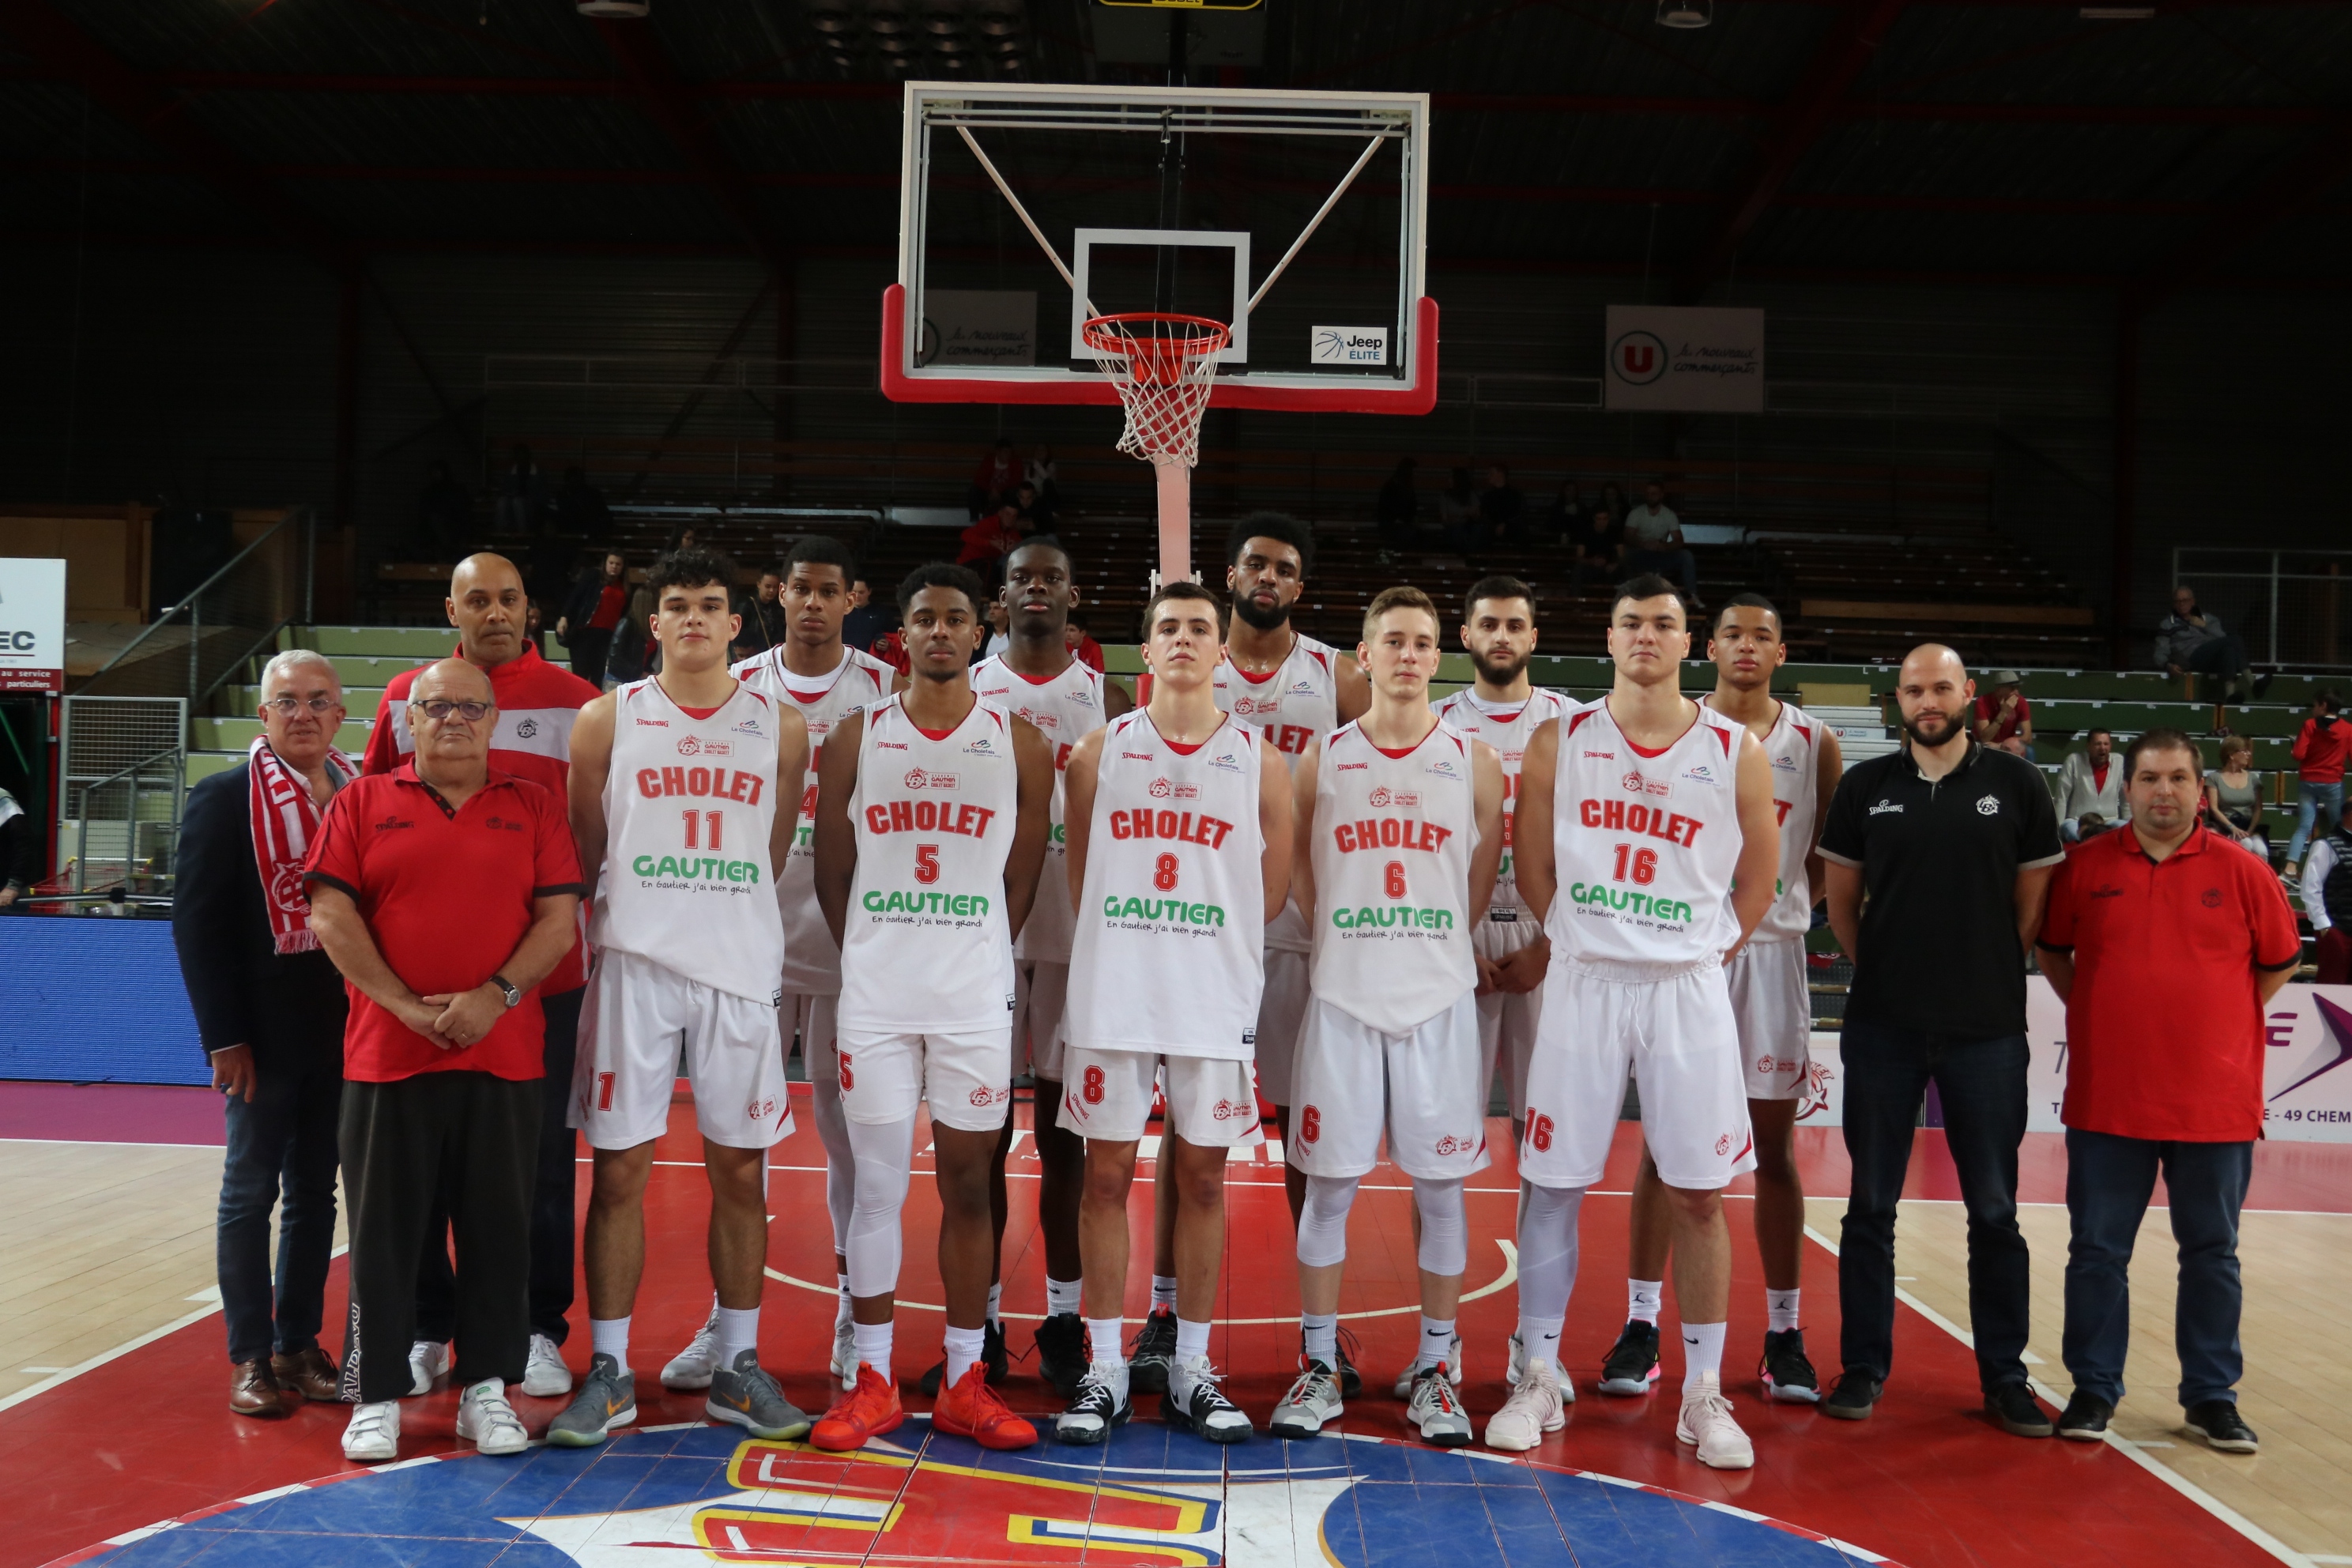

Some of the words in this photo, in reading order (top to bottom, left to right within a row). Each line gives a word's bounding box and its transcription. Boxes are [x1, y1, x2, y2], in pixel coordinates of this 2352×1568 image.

[1347, 335, 1382, 349] Jeep
[1349, 349, 1381, 360] ÉLITE
[1624, 345, 1653, 373] U
[982, 688, 1009, 696] SPALDING
[636, 718, 669, 728] SPALDING
[877, 742, 908, 751] SPALDING
[1265, 724, 1314, 755] LET
[1122, 752, 1153, 761] SPALDING
[1215, 762, 1238, 771] Choletais
[1337, 762, 1368, 771] SPALDING
[1583, 751, 1614, 760] SPALDING
[635, 766, 764, 807] CHOLET
[1433, 769, 1457, 778] Choletais
[865, 801, 996, 839] CHOLET
[1579, 798, 1704, 850] CHOLET
[1869, 805, 1903, 816] SPALDING
[682, 809, 722, 851] 11
[1110, 808, 1234, 851] CHOLET
[1333, 818, 1453, 854] CHOLET
[633, 855, 760, 884] GAUTIER
[914, 844, 940, 884] 5
[1153, 852, 1179, 892] 8
[1612, 842, 1658, 886] 16
[692, 883, 707, 894] j'ai
[710, 884, 727, 892] bien
[1384, 860, 1407, 899] 6
[863, 891, 989, 917] GAUTIER
[1104, 895, 1225, 927] GAUTIER
[1570, 882, 1693, 923] GAUTIER
[917, 918, 933, 928] j'ai
[1154, 924, 1169, 933] j'ai
[1172, 925, 1189, 934] bien
[1332, 906, 1453, 929] GAUTIER
[1577, 906, 1587, 915] En
[1619, 914, 1633, 925] j'ai
[1637, 918, 1653, 928] bien
[1389, 931, 1404, 940] j'ai
[839, 1050, 854, 1091] 5
[1083, 1065, 1105, 1105] 8
[1072, 1093, 1090, 1120] SPALDING
[2283, 1110, 2302, 1121] 49
[2307, 1110, 2352, 1123] CHEM
[1301, 1105, 1321, 1144] 6
[1525, 1106, 1554, 1152] 16
